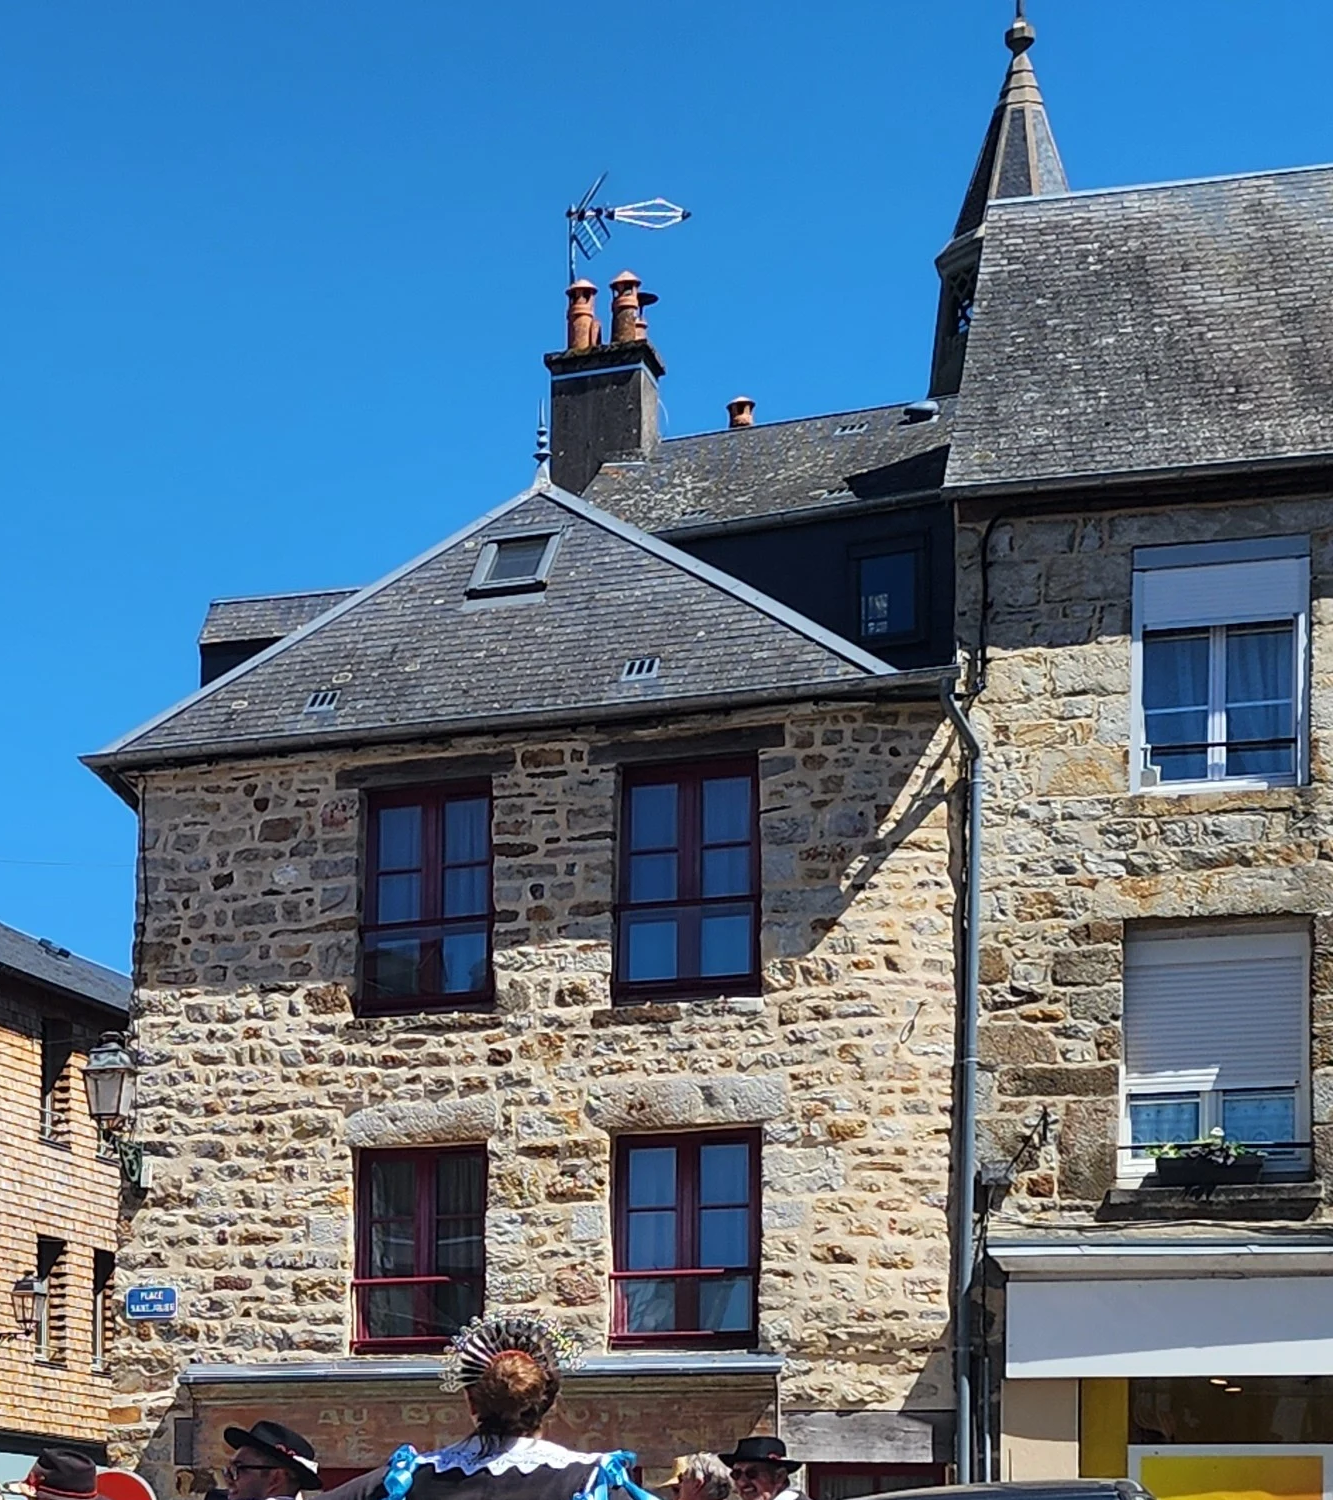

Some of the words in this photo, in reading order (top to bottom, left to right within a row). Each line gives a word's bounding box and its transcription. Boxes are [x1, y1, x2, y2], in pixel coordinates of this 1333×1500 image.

[140, 1291, 164, 1301] PLACE
[317, 1407, 368, 1425] AU
[400, 1405, 461, 1425] BO
